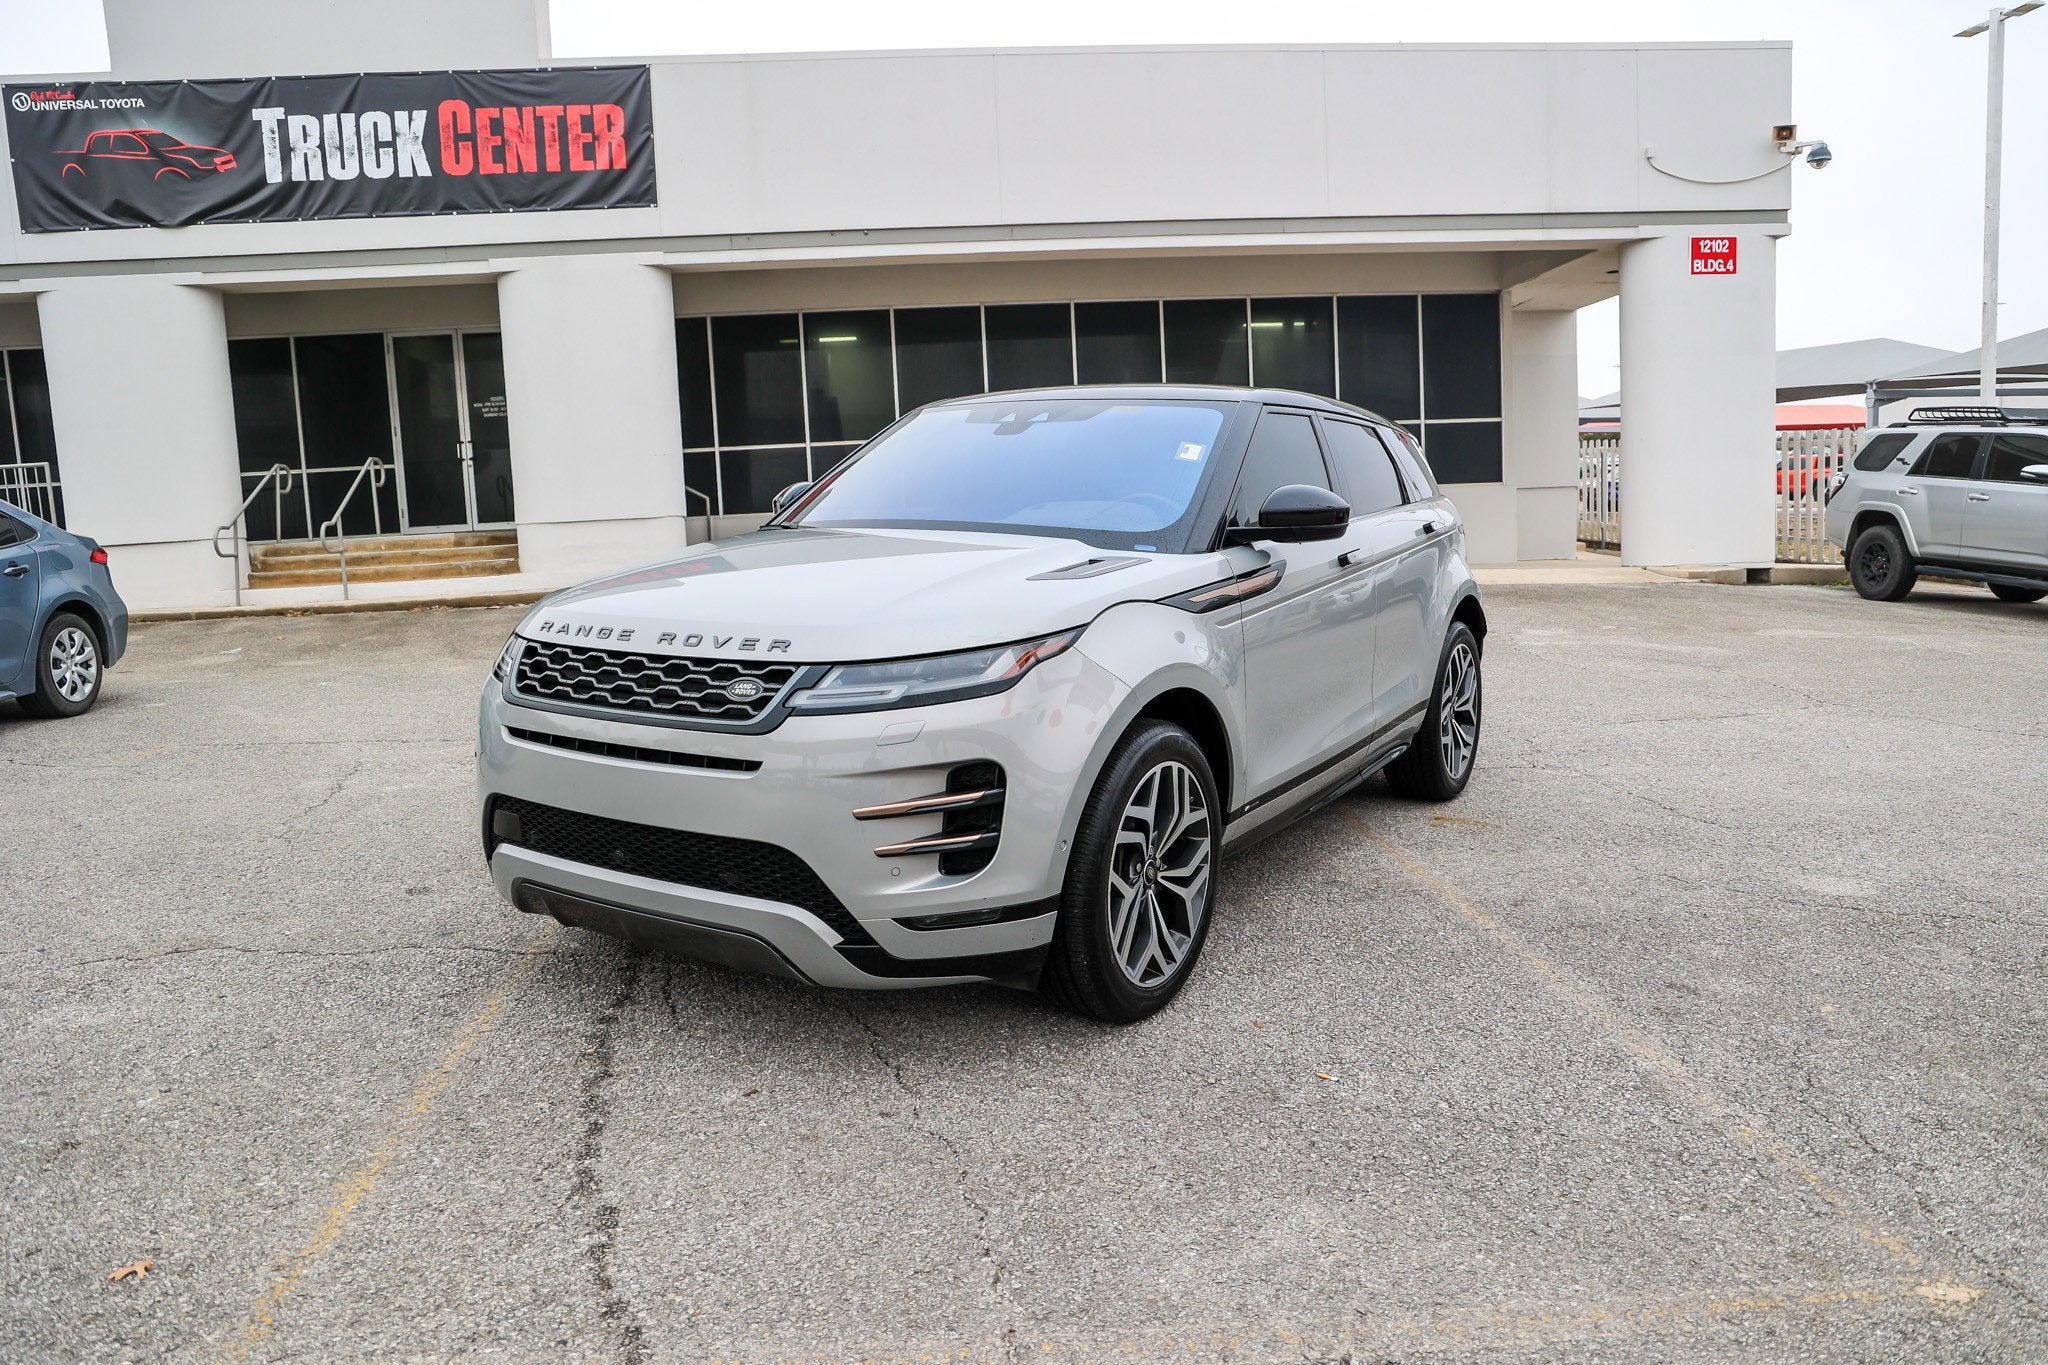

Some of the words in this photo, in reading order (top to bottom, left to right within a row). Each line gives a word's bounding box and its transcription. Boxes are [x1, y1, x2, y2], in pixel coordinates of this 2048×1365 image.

[31, 99, 99, 111] UNIVERSAL
[99, 97, 146, 109] TOYOTA
[251, 106, 433, 184] TRUCK
[437, 99, 627, 176] CENTER
[1698, 239, 1730, 254] 12102
[539, 620, 635, 642] RANGE
[656, 630, 793, 653] ROVER
